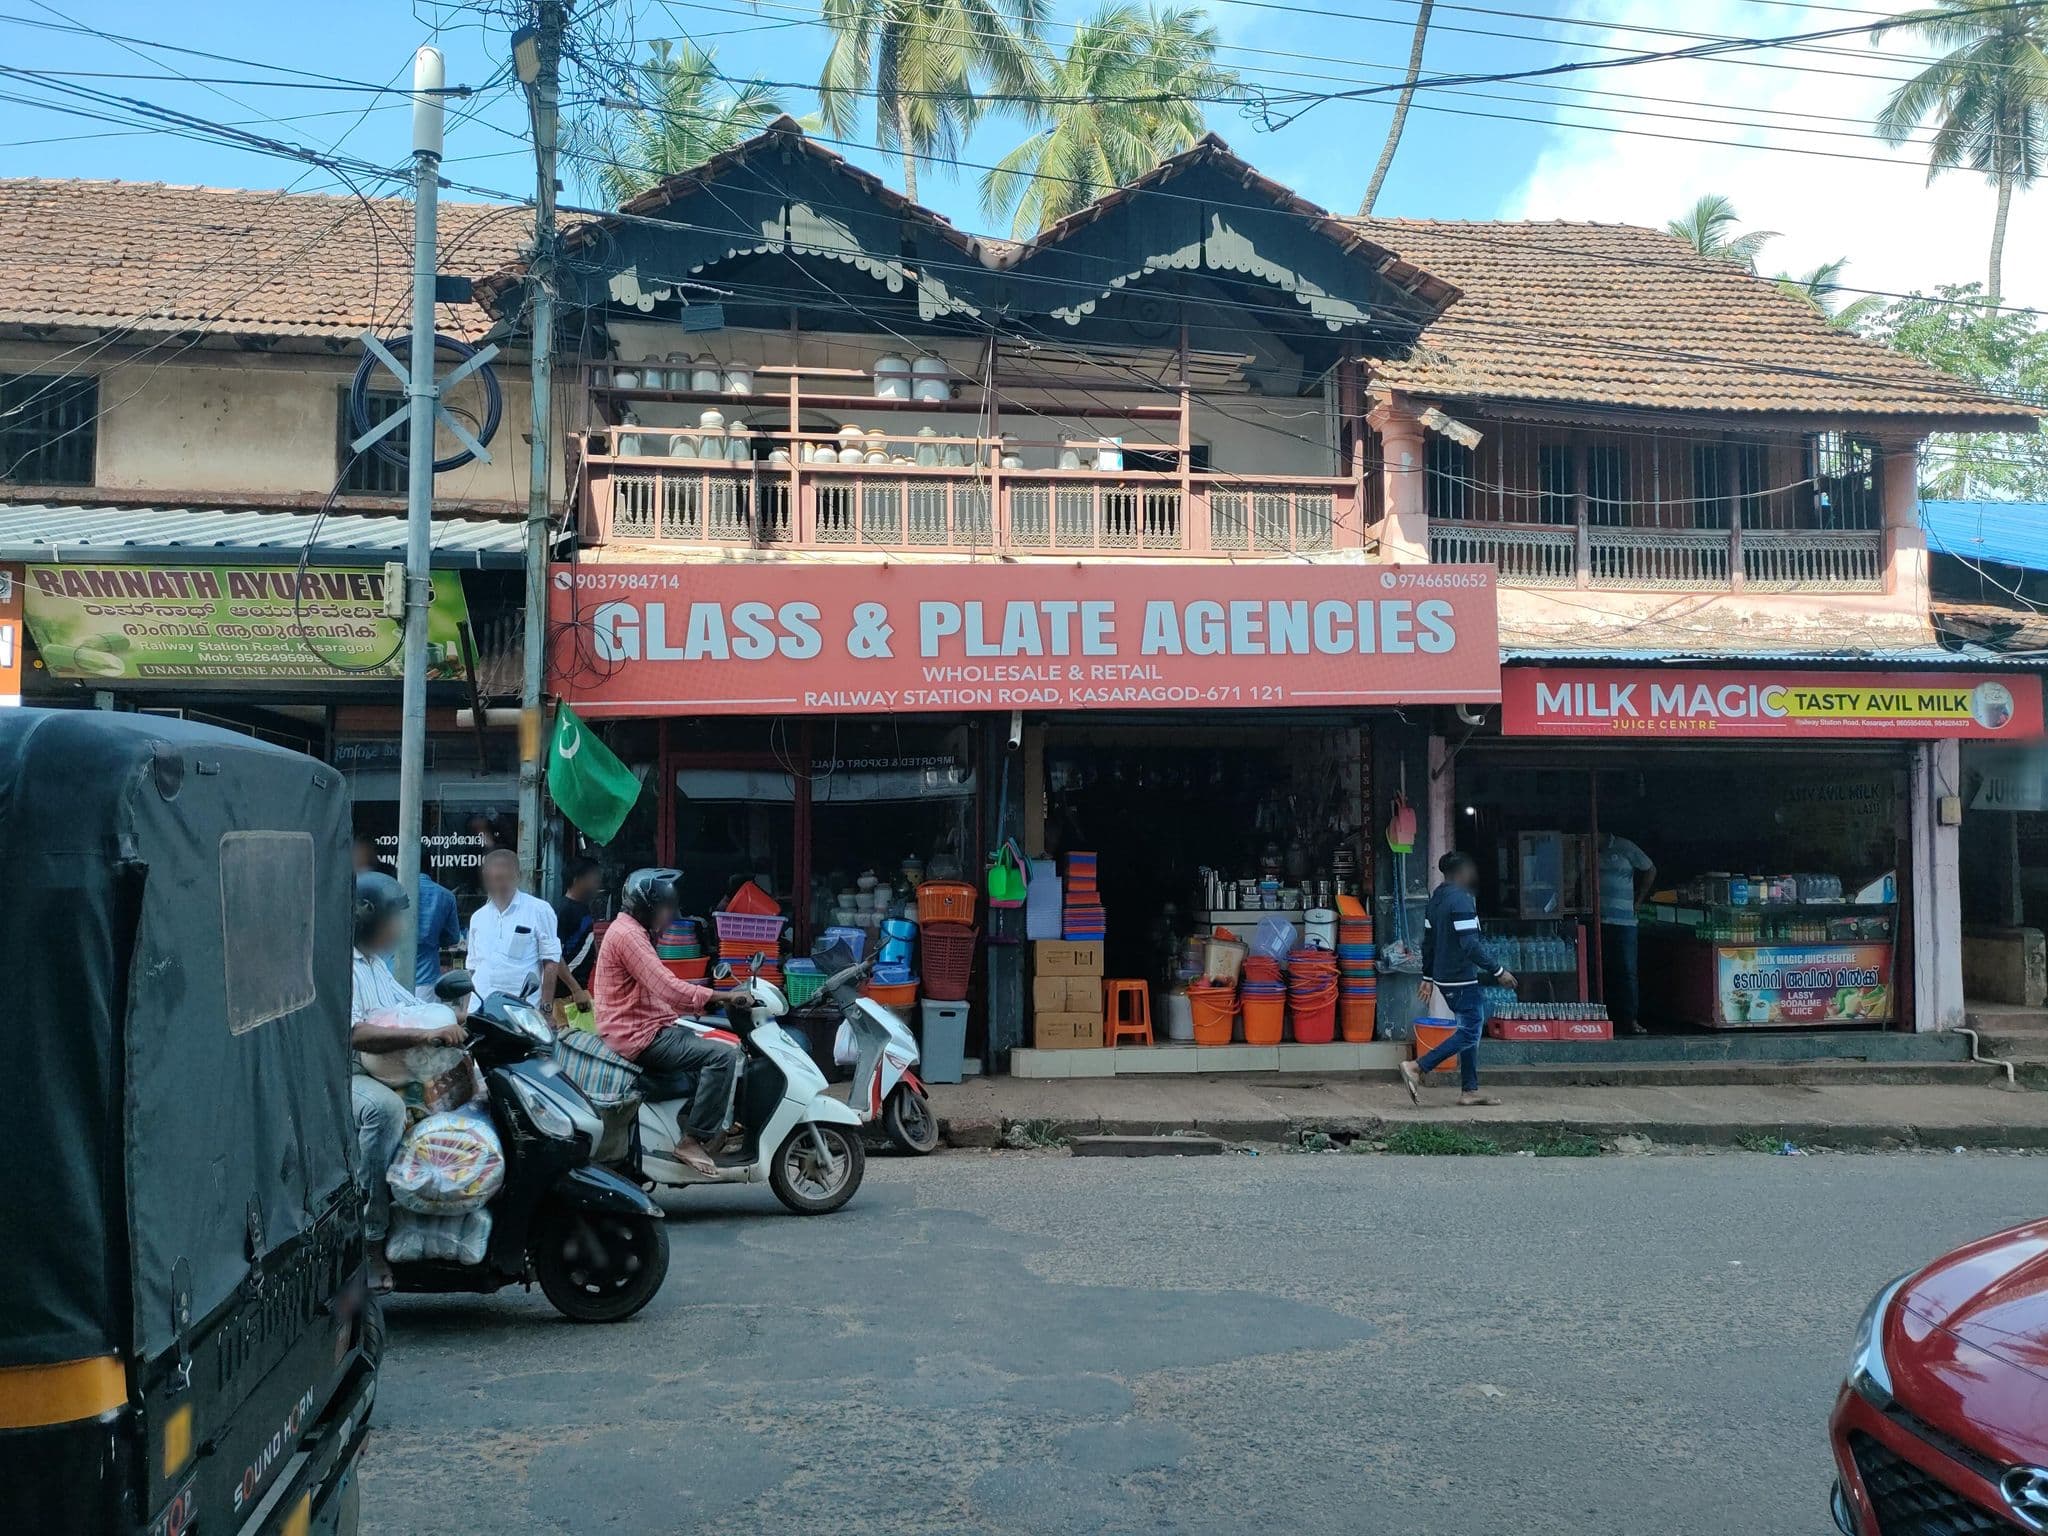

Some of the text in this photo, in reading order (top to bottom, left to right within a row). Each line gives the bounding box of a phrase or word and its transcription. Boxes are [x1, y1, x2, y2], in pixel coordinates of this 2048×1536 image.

[31, 569, 437, 602] RAMNATH AYURVED
[575, 573, 680, 591] 9037984714
[1399, 573, 1488, 589] 9746650652
[592, 599, 1457, 661] GLASS & PLATE AGENCIES
[140, 641, 193, 653] Railway
[199, 641, 251, 652] Station
[253, 642, 294, 654] Road,
[199, 652, 232, 662] Mob:
[144, 665, 194, 676] UNANI
[195, 665, 268, 677] MEDICINE
[270, 665, 346, 677] AVAILABLE
[922, 664, 1163, 682] WHOLESALE & RETAIL
[804, 690, 899, 707] RAILWAY
[903, 689, 993, 705] STATION
[998, 688, 1064, 704] ROAD,
[1249, 685, 1285, 700] 121
[1535, 682, 1790, 718] MILK MAGIC
[1795, 693, 1968, 712] TASTY AVIL MILK
[1612, 719, 1718, 730] JUICE CENTRE
[430, 854, 485, 868] YURVEDI
[1777, 953, 1803, 965] MAGIC
[1804, 953, 1827, 964] JUICE
[1787, 991, 1814, 1000] LASSY
[1781, 999, 1822, 1008] SODALIME
[1788, 1007, 1813, 1016] JUICE
[1519, 1024, 1548, 1033] SODA
[1574, 1024, 1602, 1033] SODA
[233, 1384, 315, 1513] SOUND HORN
[154, 1487, 192, 1536] TOP
